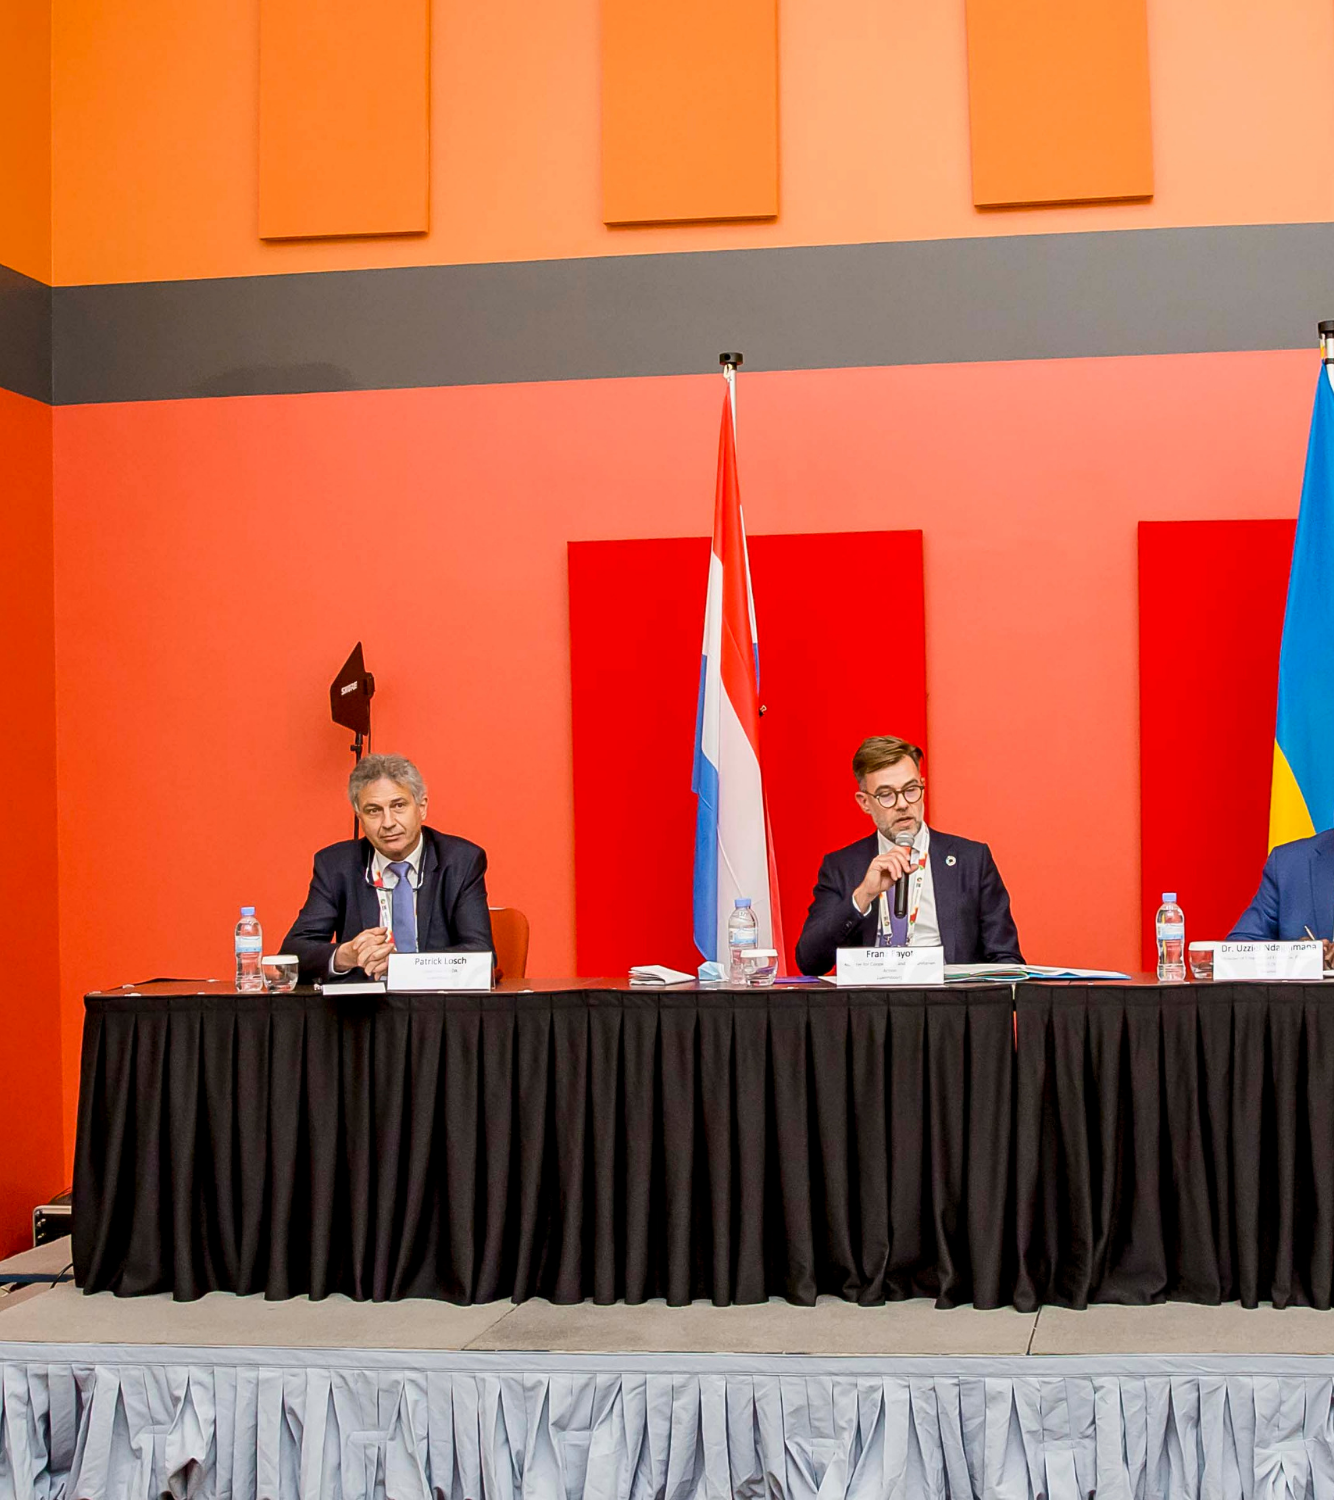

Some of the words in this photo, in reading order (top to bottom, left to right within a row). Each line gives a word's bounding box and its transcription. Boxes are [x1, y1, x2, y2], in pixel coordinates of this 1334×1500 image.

[1221, 944, 1234, 952] Dr.
[1236, 944, 1260, 952] Uzzi
[866, 950, 890, 958] Fran
[414, 957, 442, 965] Patrick
[444, 956, 467, 964] Losch
